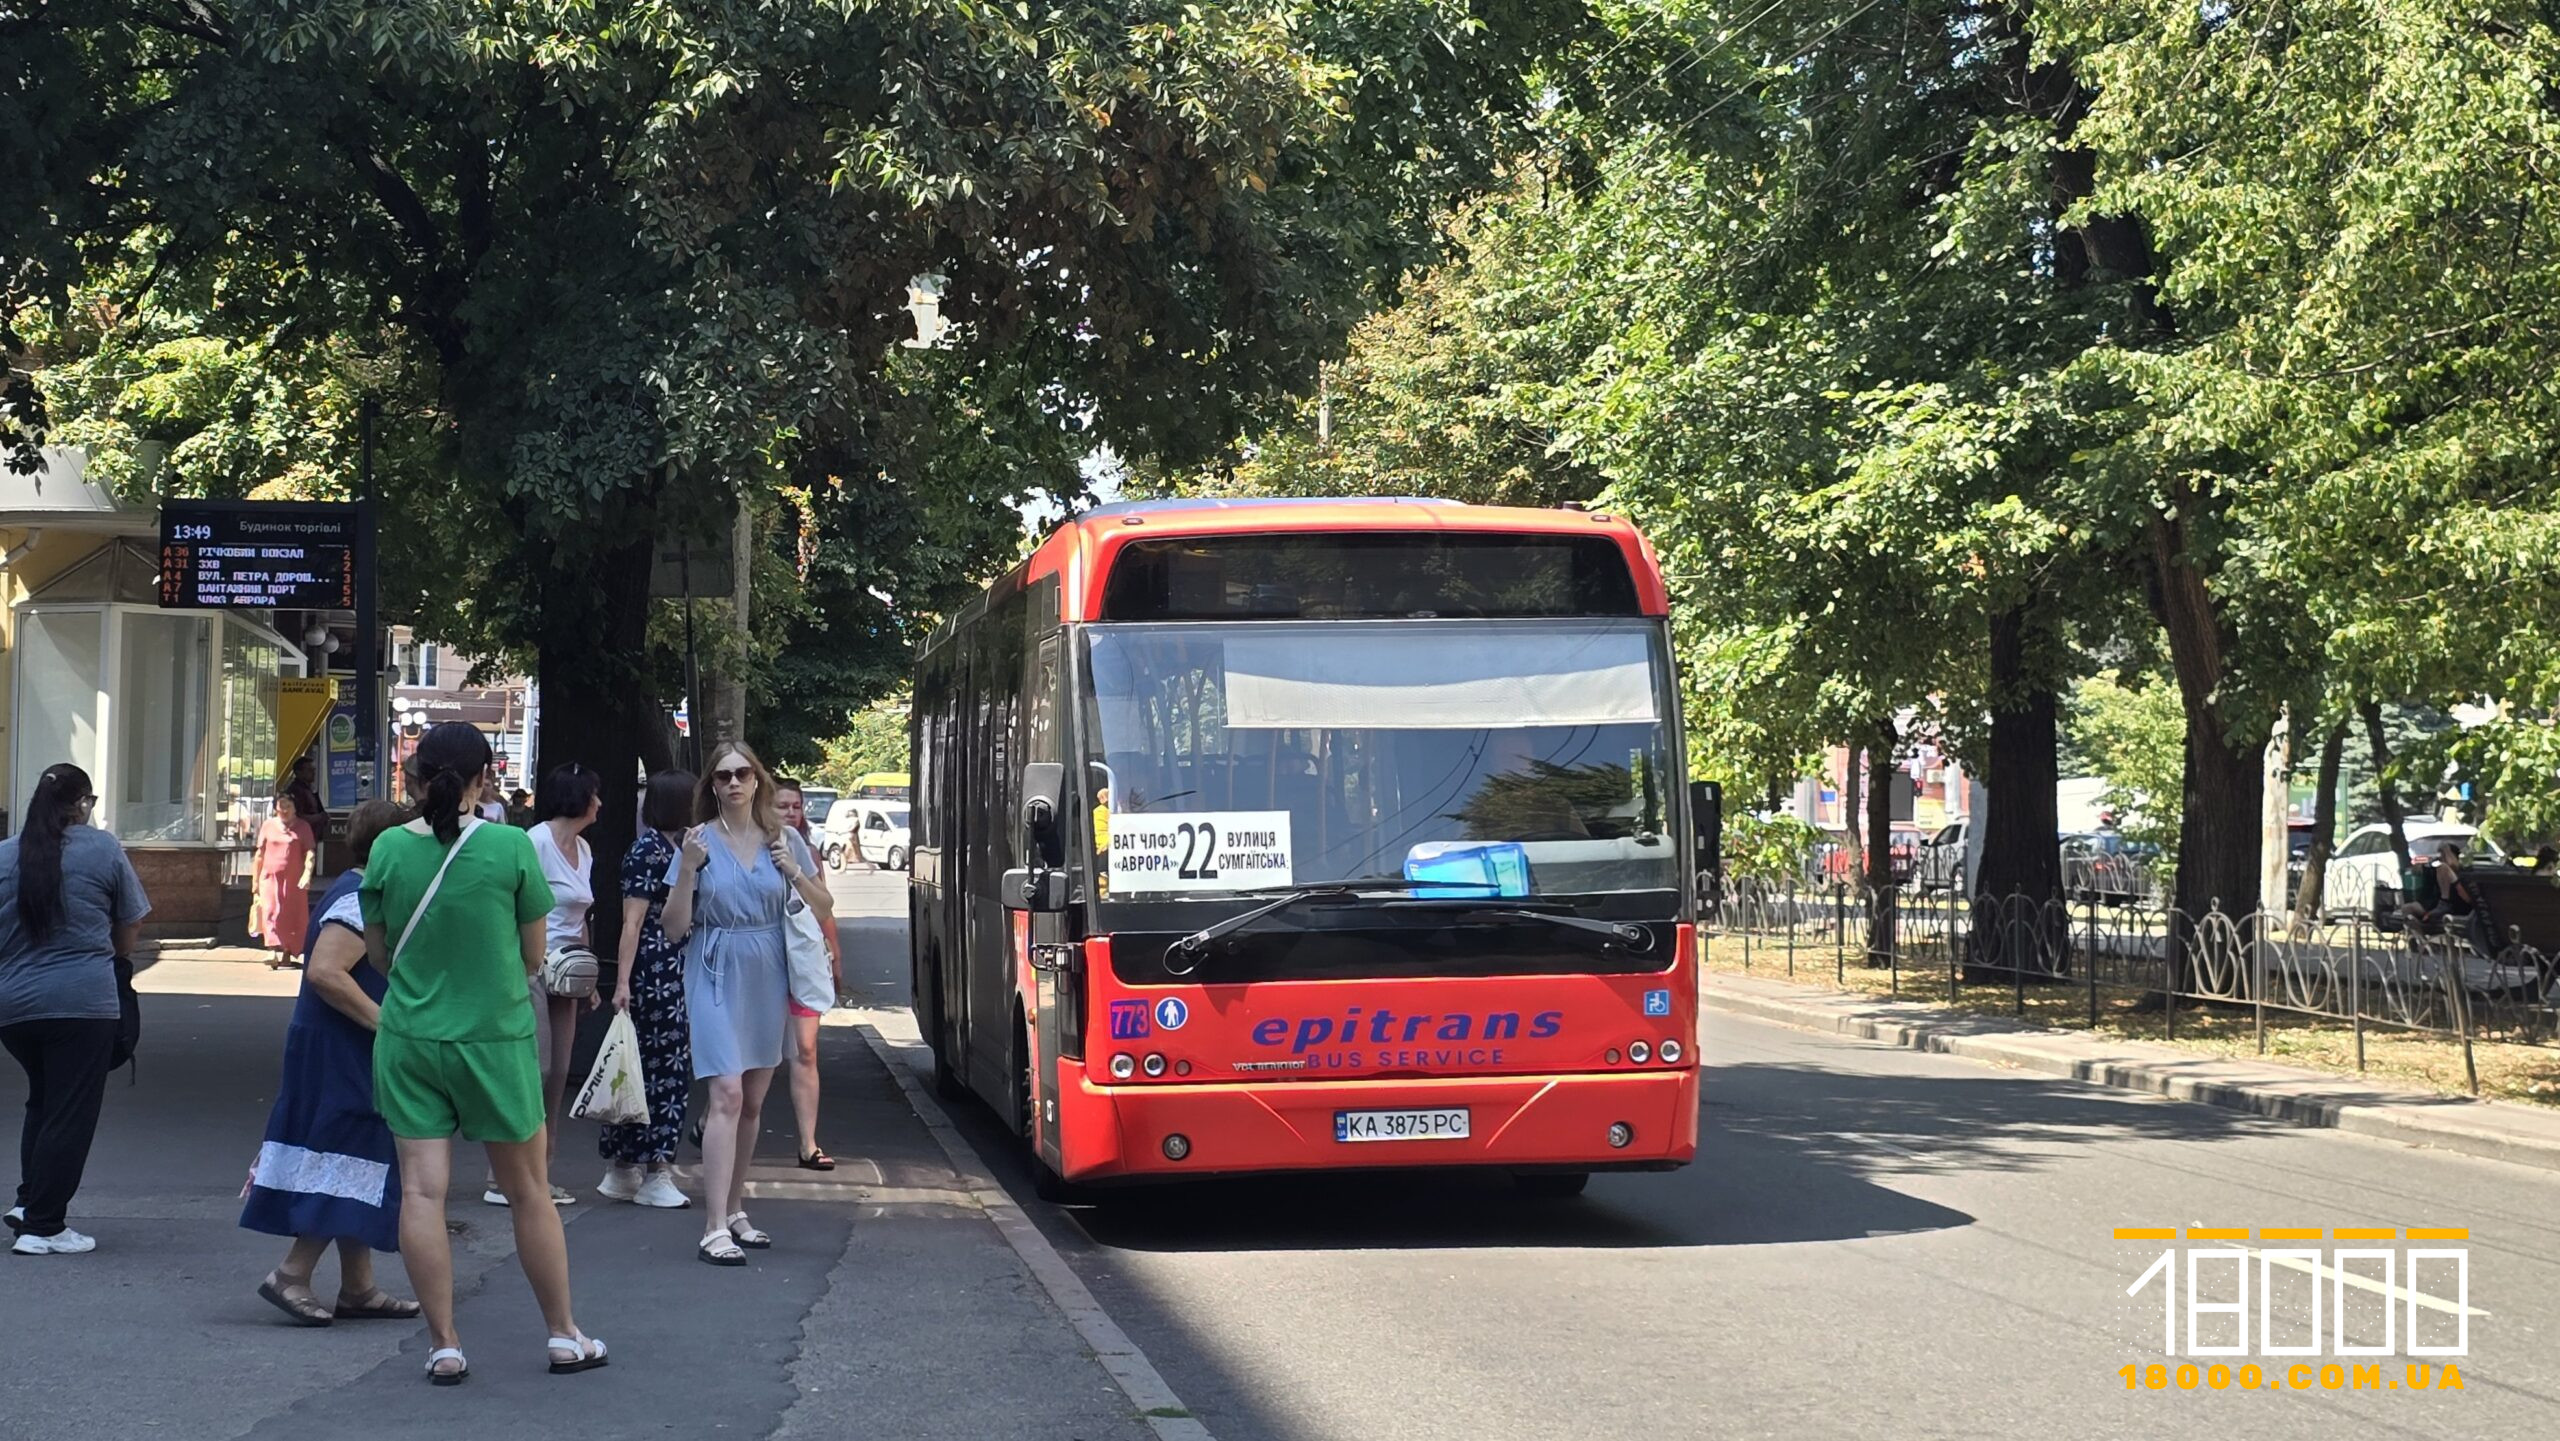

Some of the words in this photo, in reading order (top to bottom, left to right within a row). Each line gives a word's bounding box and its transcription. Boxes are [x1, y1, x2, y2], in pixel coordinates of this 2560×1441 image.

[173, 524, 211, 540] 13:49
[239, 520, 292, 533] Будинок
[294, 522, 341, 534] торгівлі
[261, 548, 305, 559] ВОКЗАЛ
[343, 550, 351, 561] 2
[174, 558, 189, 569] 31
[343, 562, 351, 572] 2
[174, 571, 182, 581] 4
[198, 571, 226, 581] ВУЛ.
[233, 571, 270, 582] ПЕТРА
[343, 574, 351, 584] 3
[174, 582, 183, 593] 7
[267, 585, 297, 595] ПОРТ
[343, 585, 351, 596] 5
[174, 593, 180, 603] 1
[233, 595, 277, 606] АВРОРА
[343, 597, 351, 607] 5
[304, 687, 325, 695] AVAL
[1113, 834, 1135, 850] ВАТ
[1141, 833, 1176, 849] ЧЛФЗ
[1228, 831, 1277, 850] ВУЛИЦЯ
[1178, 822, 1218, 880] 22
[1219, 850, 1286, 870] СУМГАЇТСЬКА
[1111, 1004, 1149, 1035] 773
[1251, 1007, 1564, 1055] epitrans
[1307, 1053, 1363, 1069] BUS
[1378, 1049, 1505, 1067] SERVICE
[1384, 1115, 1429, 1135] 3875
